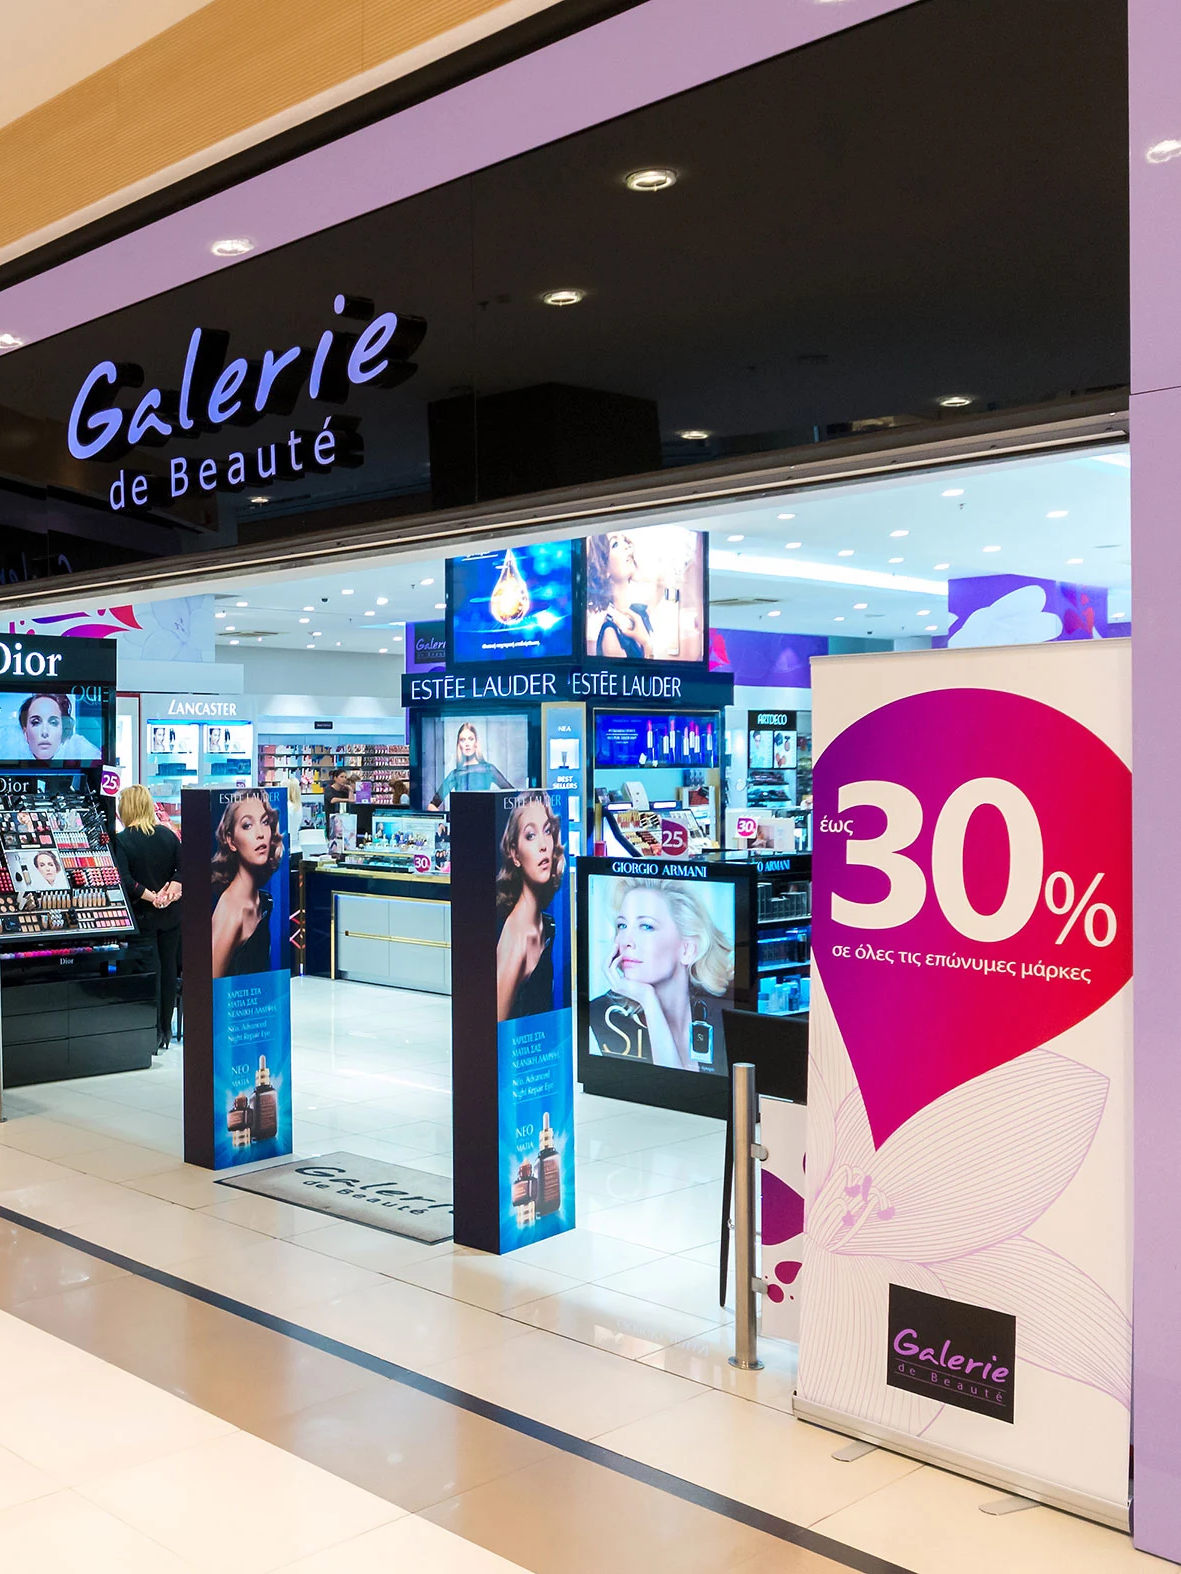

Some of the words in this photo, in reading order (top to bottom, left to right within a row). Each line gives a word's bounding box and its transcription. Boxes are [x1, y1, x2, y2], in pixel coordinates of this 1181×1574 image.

[68, 294, 398, 460] Galerie
[109, 470, 149, 511] de
[170, 416, 336, 497] Beauté
[473, 673, 557, 698] LAUDER
[623, 675, 682, 698] LAUDER
[168, 699, 237, 716] LANCASTER
[757, 713, 788, 726] ARTDECO
[820, 815, 854, 836] έως
[612, 862, 658, 876] GIORGIO
[662, 866, 707, 878] ARMANI
[764, 859, 791, 872] ARMANI
[831, 777, 1118, 948] 30%
[59, 958, 75, 966] Dior
[832, 943, 851, 959] σε
[855, 943, 895, 965] όλες
[898, 949, 922, 967] τις
[925, 950, 1017, 977] επώνυμες
[1021, 962, 1092, 985] μάρκες
[303, 1180, 330, 1190] de
[336, 1188, 429, 1215] Beauté
[893, 1328, 1010, 1383] Galerie
[898, 1363, 916, 1376] de
[931, 1372, 1003, 1403] Beauté
